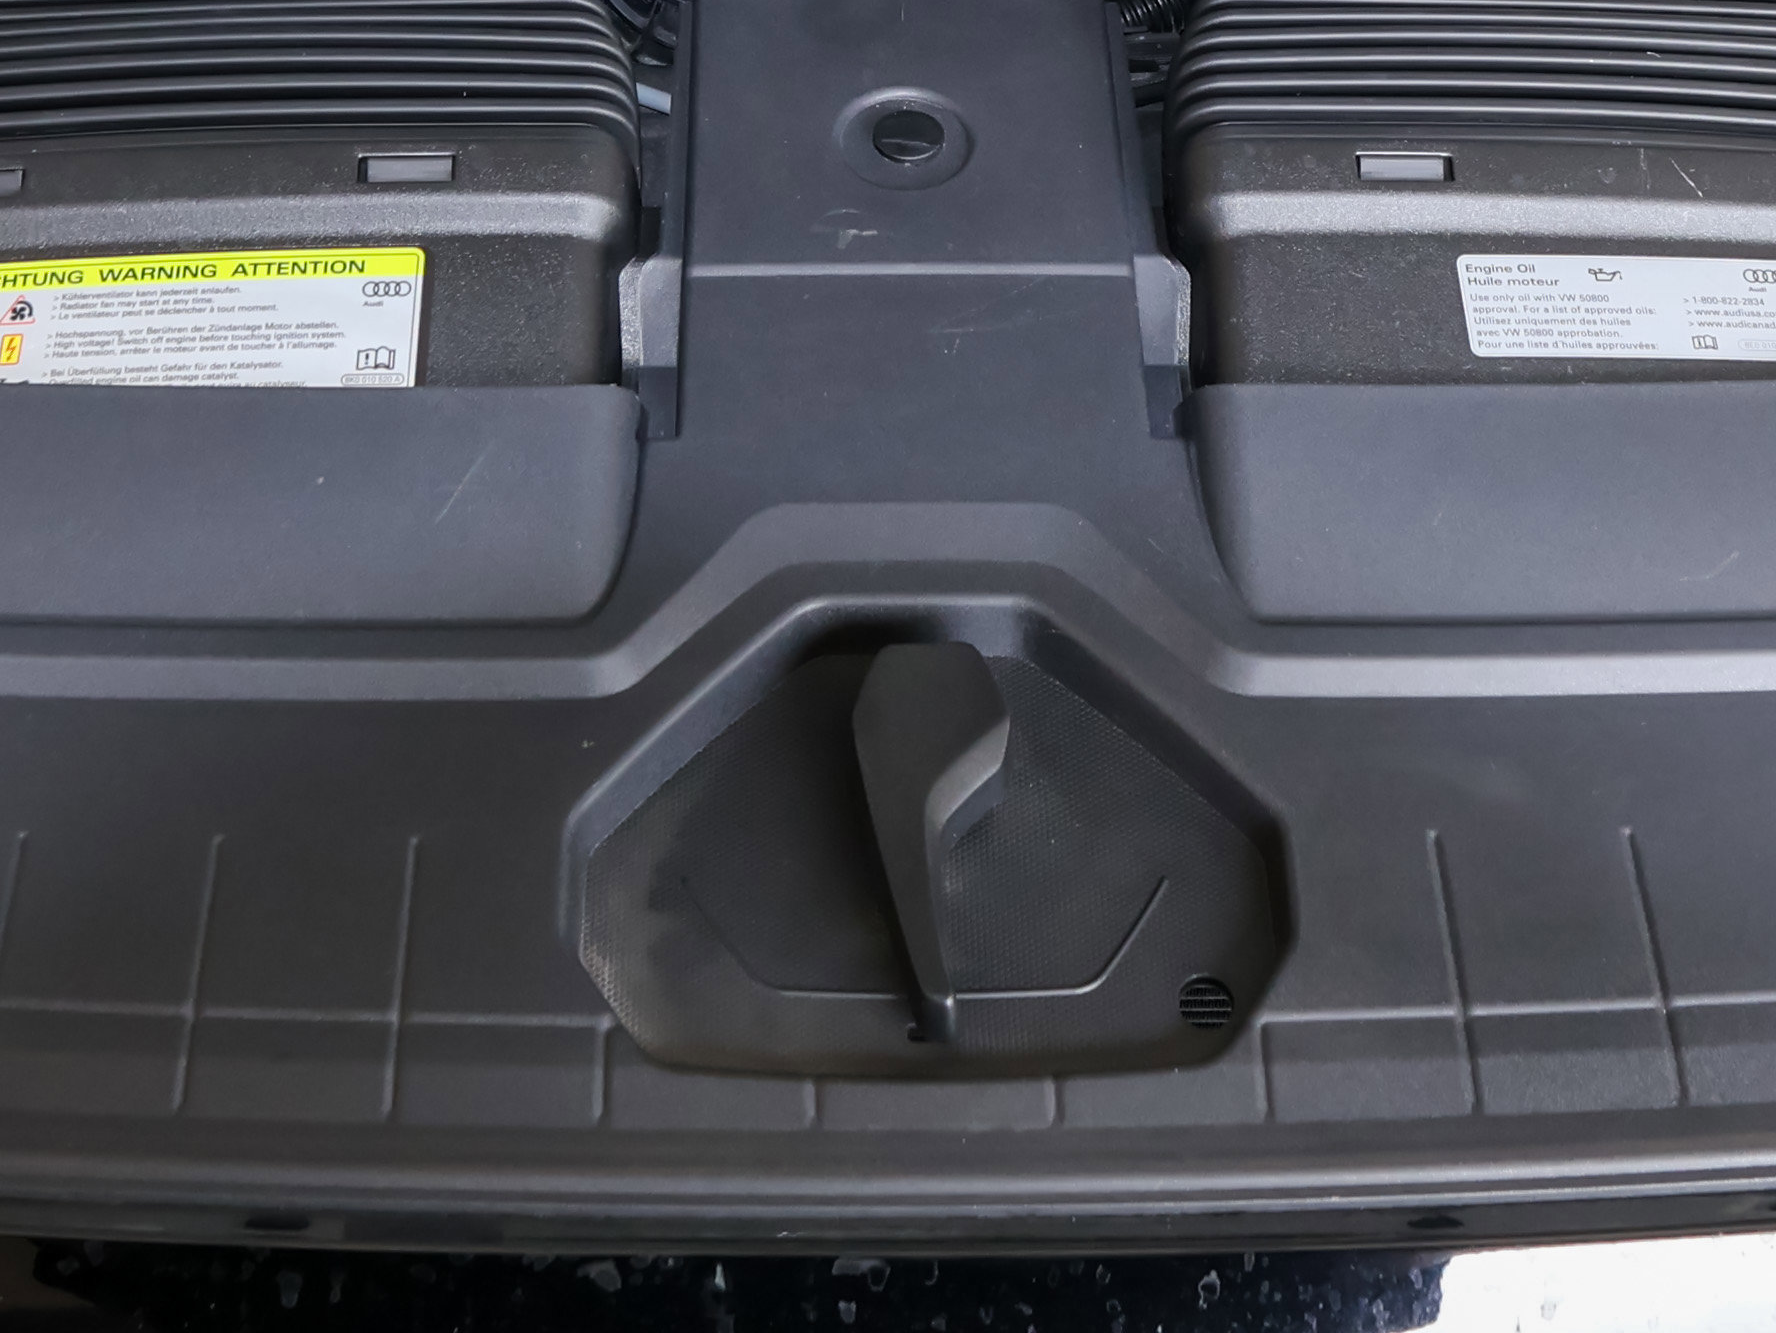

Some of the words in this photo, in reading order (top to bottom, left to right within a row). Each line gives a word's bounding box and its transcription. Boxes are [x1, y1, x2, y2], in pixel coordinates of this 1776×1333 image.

[98, 264, 218, 283] WARNING
[230, 260, 367, 277] ATTENTION
[1465, 264, 1513, 276] Engine
[1516, 263, 1537, 274] Oil
[1467, 276, 1504, 287] Huile
[1507, 277, 1561, 287] moteur
[61, 290, 134, 302] Kühlerventilator
[135, 289, 158, 298] kann
[159, 287, 199, 298] jederzeit
[200, 286, 242, 295] anlaufen.
[1470, 293, 1491, 302] Use
[1492, 293, 1516, 304] only
[1518, 293, 1532, 303] oil
[1533, 293, 1557, 303] with
[1557, 294, 1577, 303] VW
[1579, 294, 1610, 303] 50800
[60, 301, 98, 311] Radiator
[100, 299, 115, 308] fan
[117, 300, 137, 309] may
[138, 298, 160, 307] start
[162, 297, 171, 306] at
[172, 298, 190, 307] any
[191, 296, 215, 305] time.
[58, 311, 70, 320] Le
[71, 310, 120, 321] ventilateur
[122, 309, 143, 319] peut
[144, 308, 155, 316] se
[156, 305, 207, 316] déclencher
[216, 305, 236, 314] tout
[237, 304, 279, 313] moment.
[1473, 305, 1521, 315] approval.
[1523, 305, 1541, 315] For
[1542, 306, 1550, 314] a
[1551, 305, 1569, 315] list
[1570, 305, 1582, 315] of
[1583, 305, 1633, 317] approved
[1635, 306, 1657, 316] oils:
[128, 328, 144, 336] vor
[146, 326, 189, 336] Berühren
[190, 324, 206, 333] der
[207, 323, 263, 335] Zündanlage
[264, 323, 294, 332] Motor
[295, 321, 340, 331] abstellen.
[1474, 316, 1512, 326] Utilisez
[1514, 317, 1577, 328] uniquement
[1579, 316, 1598, 326] des
[1600, 316, 1632, 327] huiles
[53, 341, 75, 351] High
[77, 339, 116, 349] voltage!
[117, 337, 148, 346] Switch
[150, 335, 166, 344] off
[165, 336, 197, 346] engine
[198, 333, 228, 342] before
[230, 332, 272, 342] touching
[273, 330, 309, 341] ignition
[310, 331, 346, 340] system.
[1476, 329, 1500, 338] avec
[1502, 328, 1521, 337] VW
[1523, 328, 1554, 338] 50800
[1556, 328, 1624, 341] approbation.
[51, 350, 79, 359] Haute
[120, 346, 150, 356] arrêter
[152, 345, 162, 354] le
[163, 345, 197, 354] moteur
[198, 344, 224, 353] avant
[226, 342, 239, 351] de
[240, 341, 276, 351] toucher
[1477, 339, 1501, 349] Pour
[1504, 341, 1525, 349] une
[1527, 339, 1550, 349] liste
[1595, 340, 1660, 353] approuvées:
[50, 369, 65, 378] Bei
[124, 365, 159, 375] besteht
[160, 363, 192, 373] Gefahr
[194, 362, 208, 371] für
[209, 362, 228, 371] den
[229, 360, 284, 371] Katalysator.
[129, 374, 143, 384] oil
[143, 374, 161, 383] can
[162, 373, 200, 385] damage
